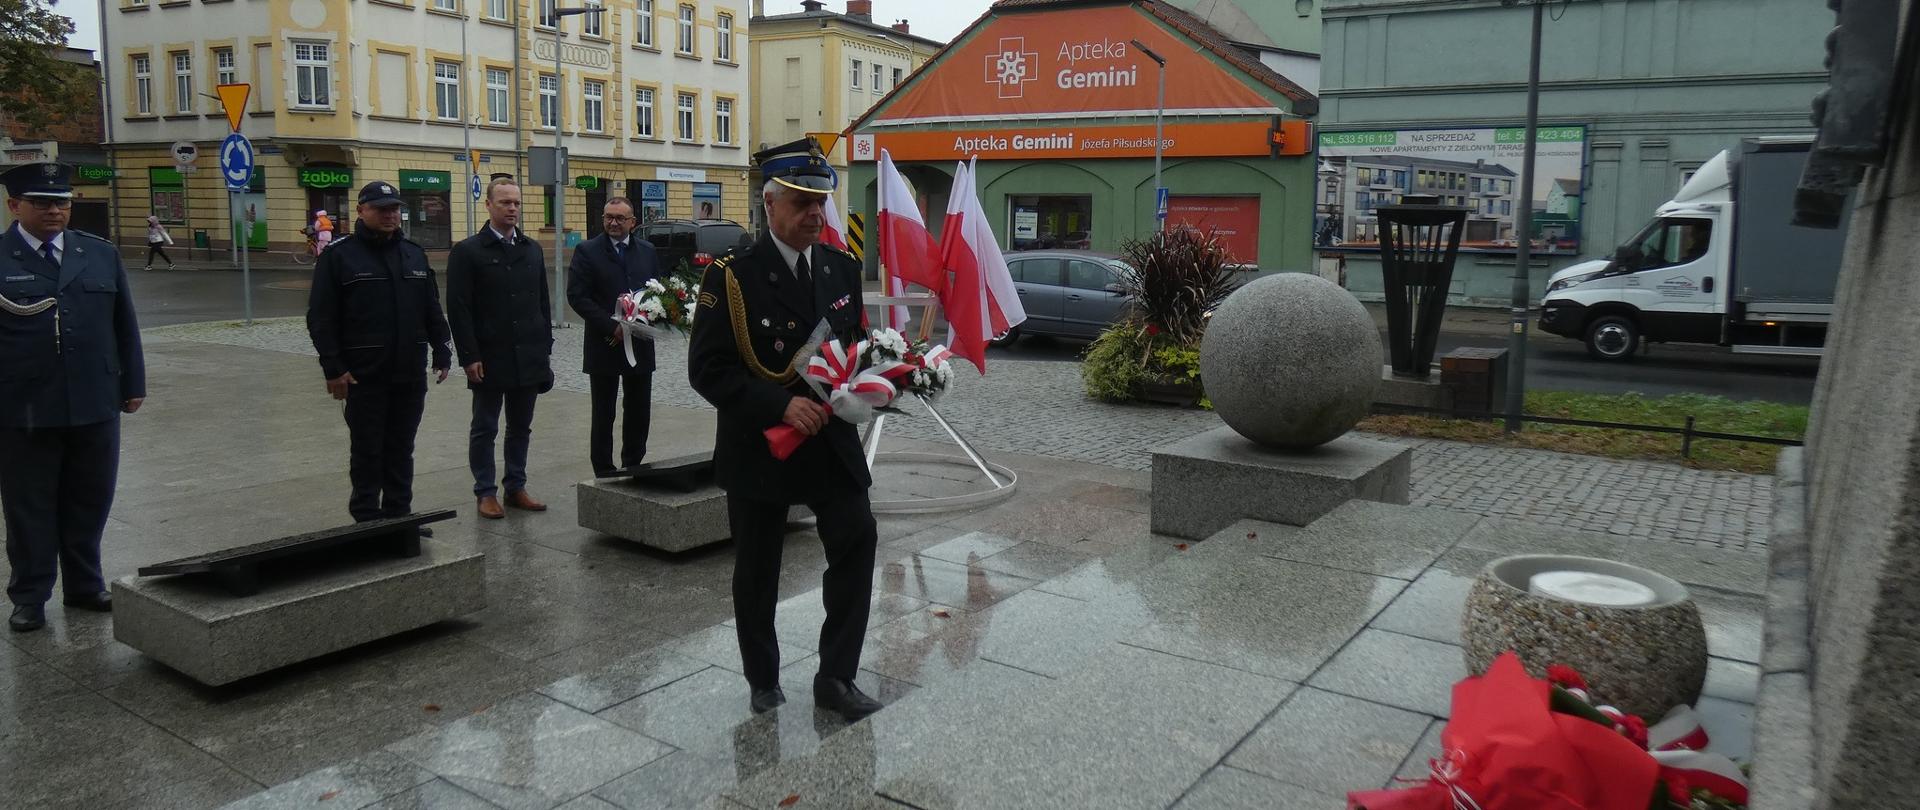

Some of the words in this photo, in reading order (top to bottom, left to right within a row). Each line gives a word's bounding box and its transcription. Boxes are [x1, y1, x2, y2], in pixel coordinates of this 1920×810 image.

[1057, 37, 1126, 66] Apteka
[1057, 64, 1137, 88] Gemini
[1322, 136, 1336, 144] tel.
[1338, 135, 1355, 143] 533
[1357, 135, 1374, 143] 516
[1378, 134, 1393, 143] 112
[1411, 134, 1424, 142] NA
[1425, 133, 1476, 142] SPRZEDAŻ
[1537, 130, 1557, 139] 423
[1559, 129, 1580, 138] 404
[954, 134, 1008, 154] Apteka
[1012, 133, 1073, 150] Gemini
[1080, 138, 1110, 150] Józefa
[1113, 137, 1175, 150] Piłsudskigo
[1393, 145, 1446, 153] APARTAMENTY
[1454, 144, 1495, 152] ZIELONYMI
[84, 168, 112, 176] żabka
[302, 171, 350, 183] żabka
